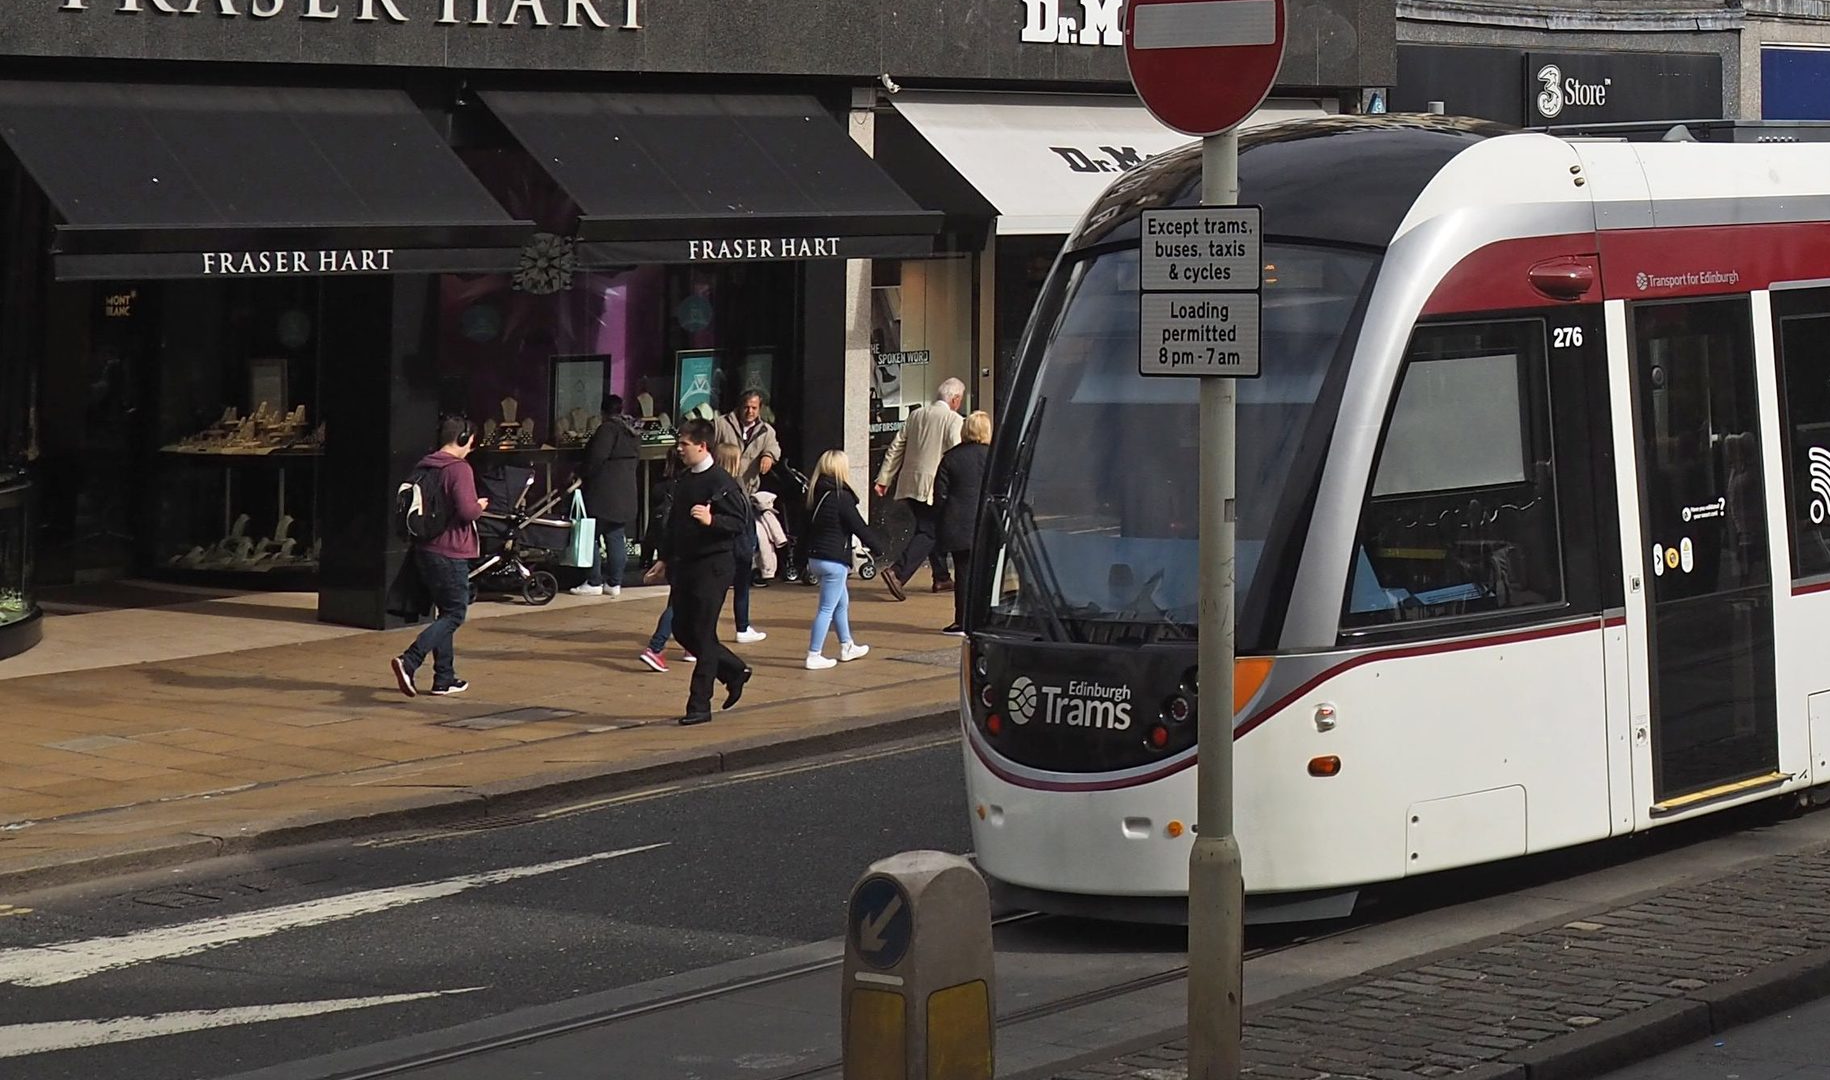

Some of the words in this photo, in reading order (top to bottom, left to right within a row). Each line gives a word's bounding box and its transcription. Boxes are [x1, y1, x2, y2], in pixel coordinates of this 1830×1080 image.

[1537, 64, 1563, 119] 3
[1564, 77, 1606, 106] Store
[1049, 146, 1157, 173] Dr.M
[1148, 218, 1199, 238] Except
[688, 238, 775, 261] FRASER
[781, 236, 841, 259] HART
[1208, 239, 1246, 257] taxis
[202, 250, 310, 275] FRASER
[318, 248, 395, 273] HART
[1168, 263, 1179, 280] &
[1183, 263, 1231, 283] cycles
[1648, 273, 1687, 289] Transport
[1687, 272, 1699, 286] for
[1700, 270, 1739, 285] Edinburgh
[1170, 301, 1229, 322] Loading
[1162, 324, 1236, 344] permitted
[1553, 326, 1583, 348] 276
[878, 352, 906, 365] SPOKEN
[907, 350, 929, 363] WORD
[1068, 680, 1131, 702] Edinburgh
[1041, 686, 1132, 731] Trams
